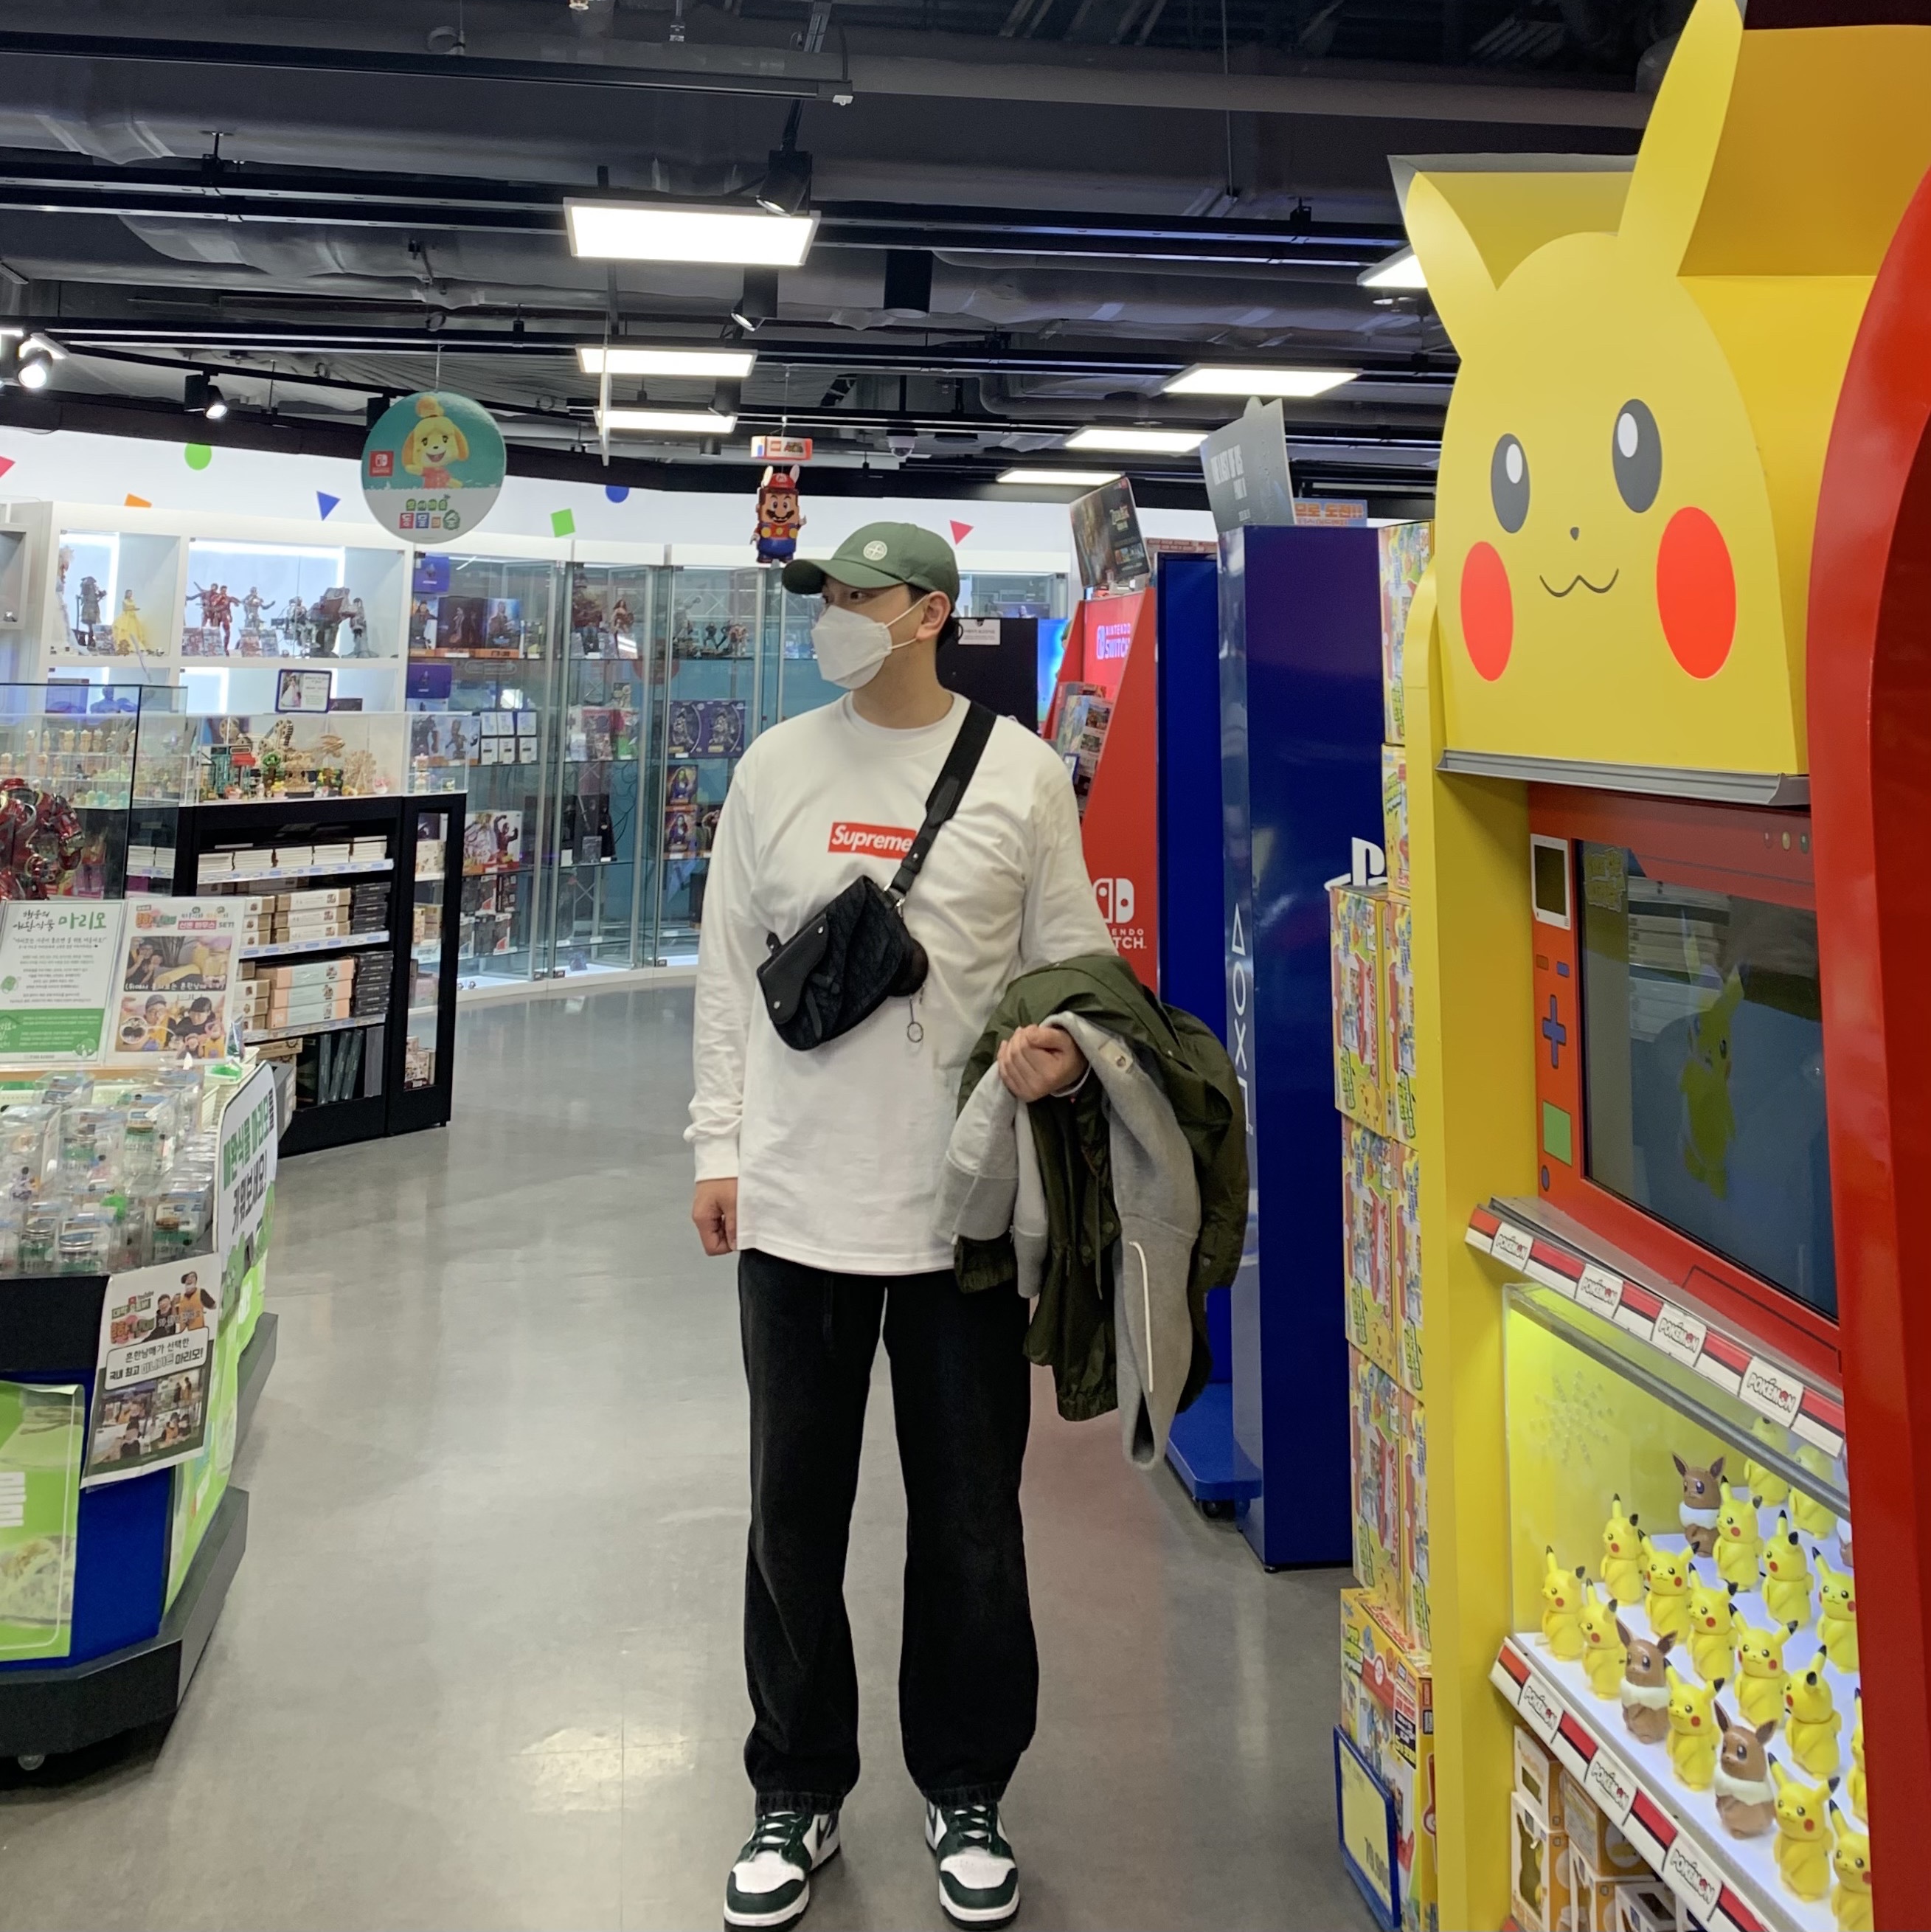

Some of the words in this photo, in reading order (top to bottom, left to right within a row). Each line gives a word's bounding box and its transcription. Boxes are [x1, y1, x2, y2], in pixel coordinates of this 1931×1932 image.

[831, 825, 913, 852] Supreme
[1112, 928, 1144, 936] ENDO
[1112, 936, 1145, 949] TCH
[125, 1344, 164, 1363] 흔한남매가
[167, 1337, 190, 1352] 선택한
[1657, 1317, 1700, 1354] POKÉMON
[109, 1368, 123, 1380] 국내
[125, 1365, 139, 1378] 최고
[175, 1348, 203, 1365] 마리모!
[1746, 1371, 1797, 1413] POKÉMON
[1669, 1848, 1716, 1905] POKÉMON
